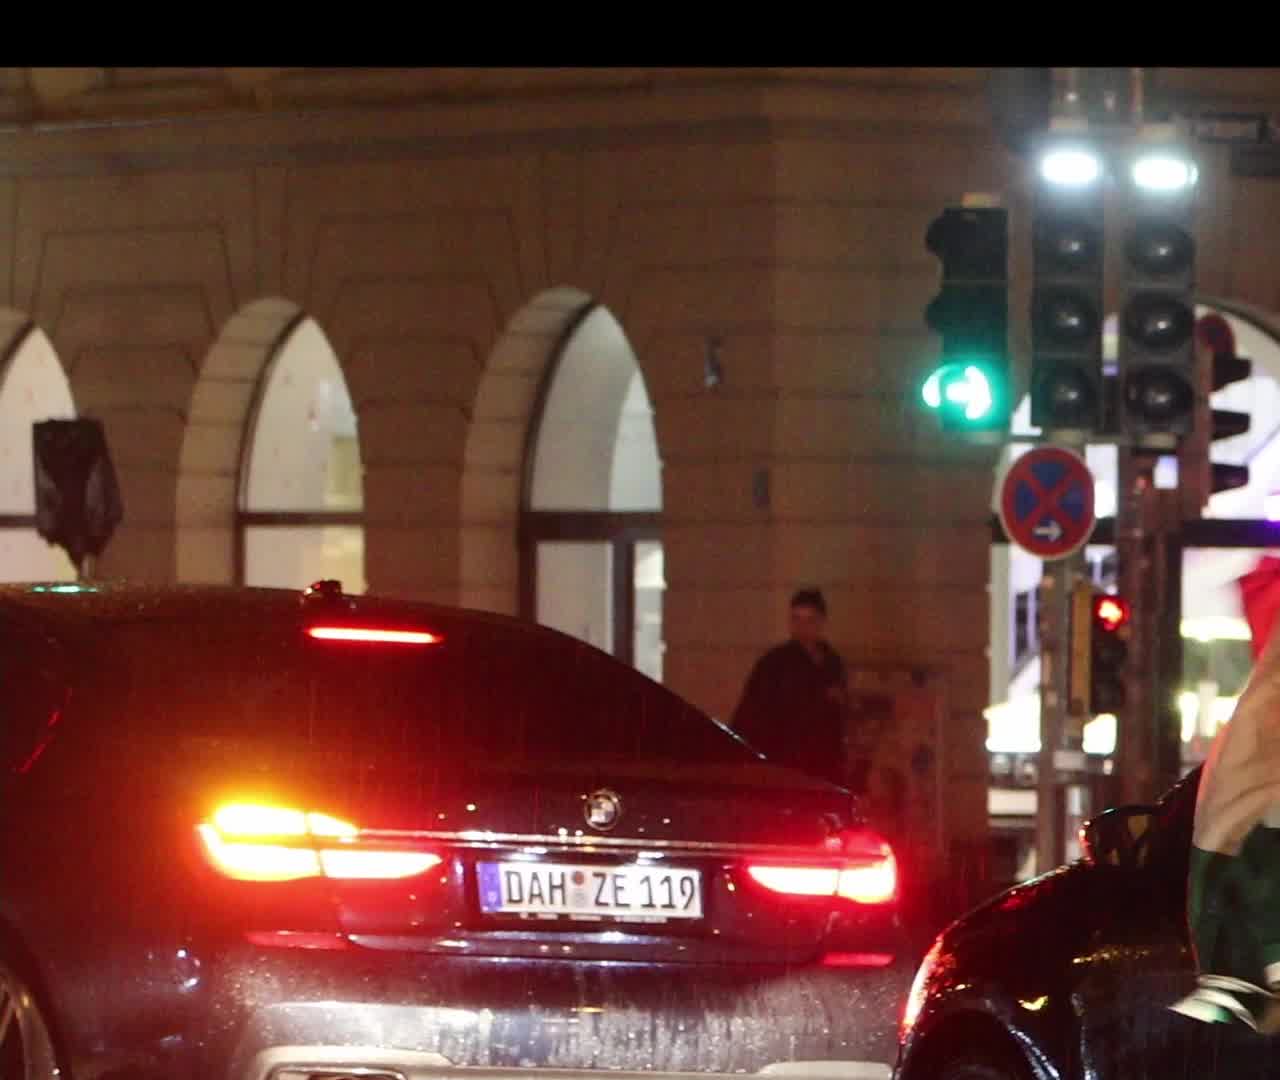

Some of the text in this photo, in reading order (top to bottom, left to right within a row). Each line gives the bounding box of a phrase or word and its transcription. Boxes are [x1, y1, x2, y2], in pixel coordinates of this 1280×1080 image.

[505, 870, 566, 906] DAH
[592, 872, 631, 908] ZE
[640, 874, 696, 911] 119
